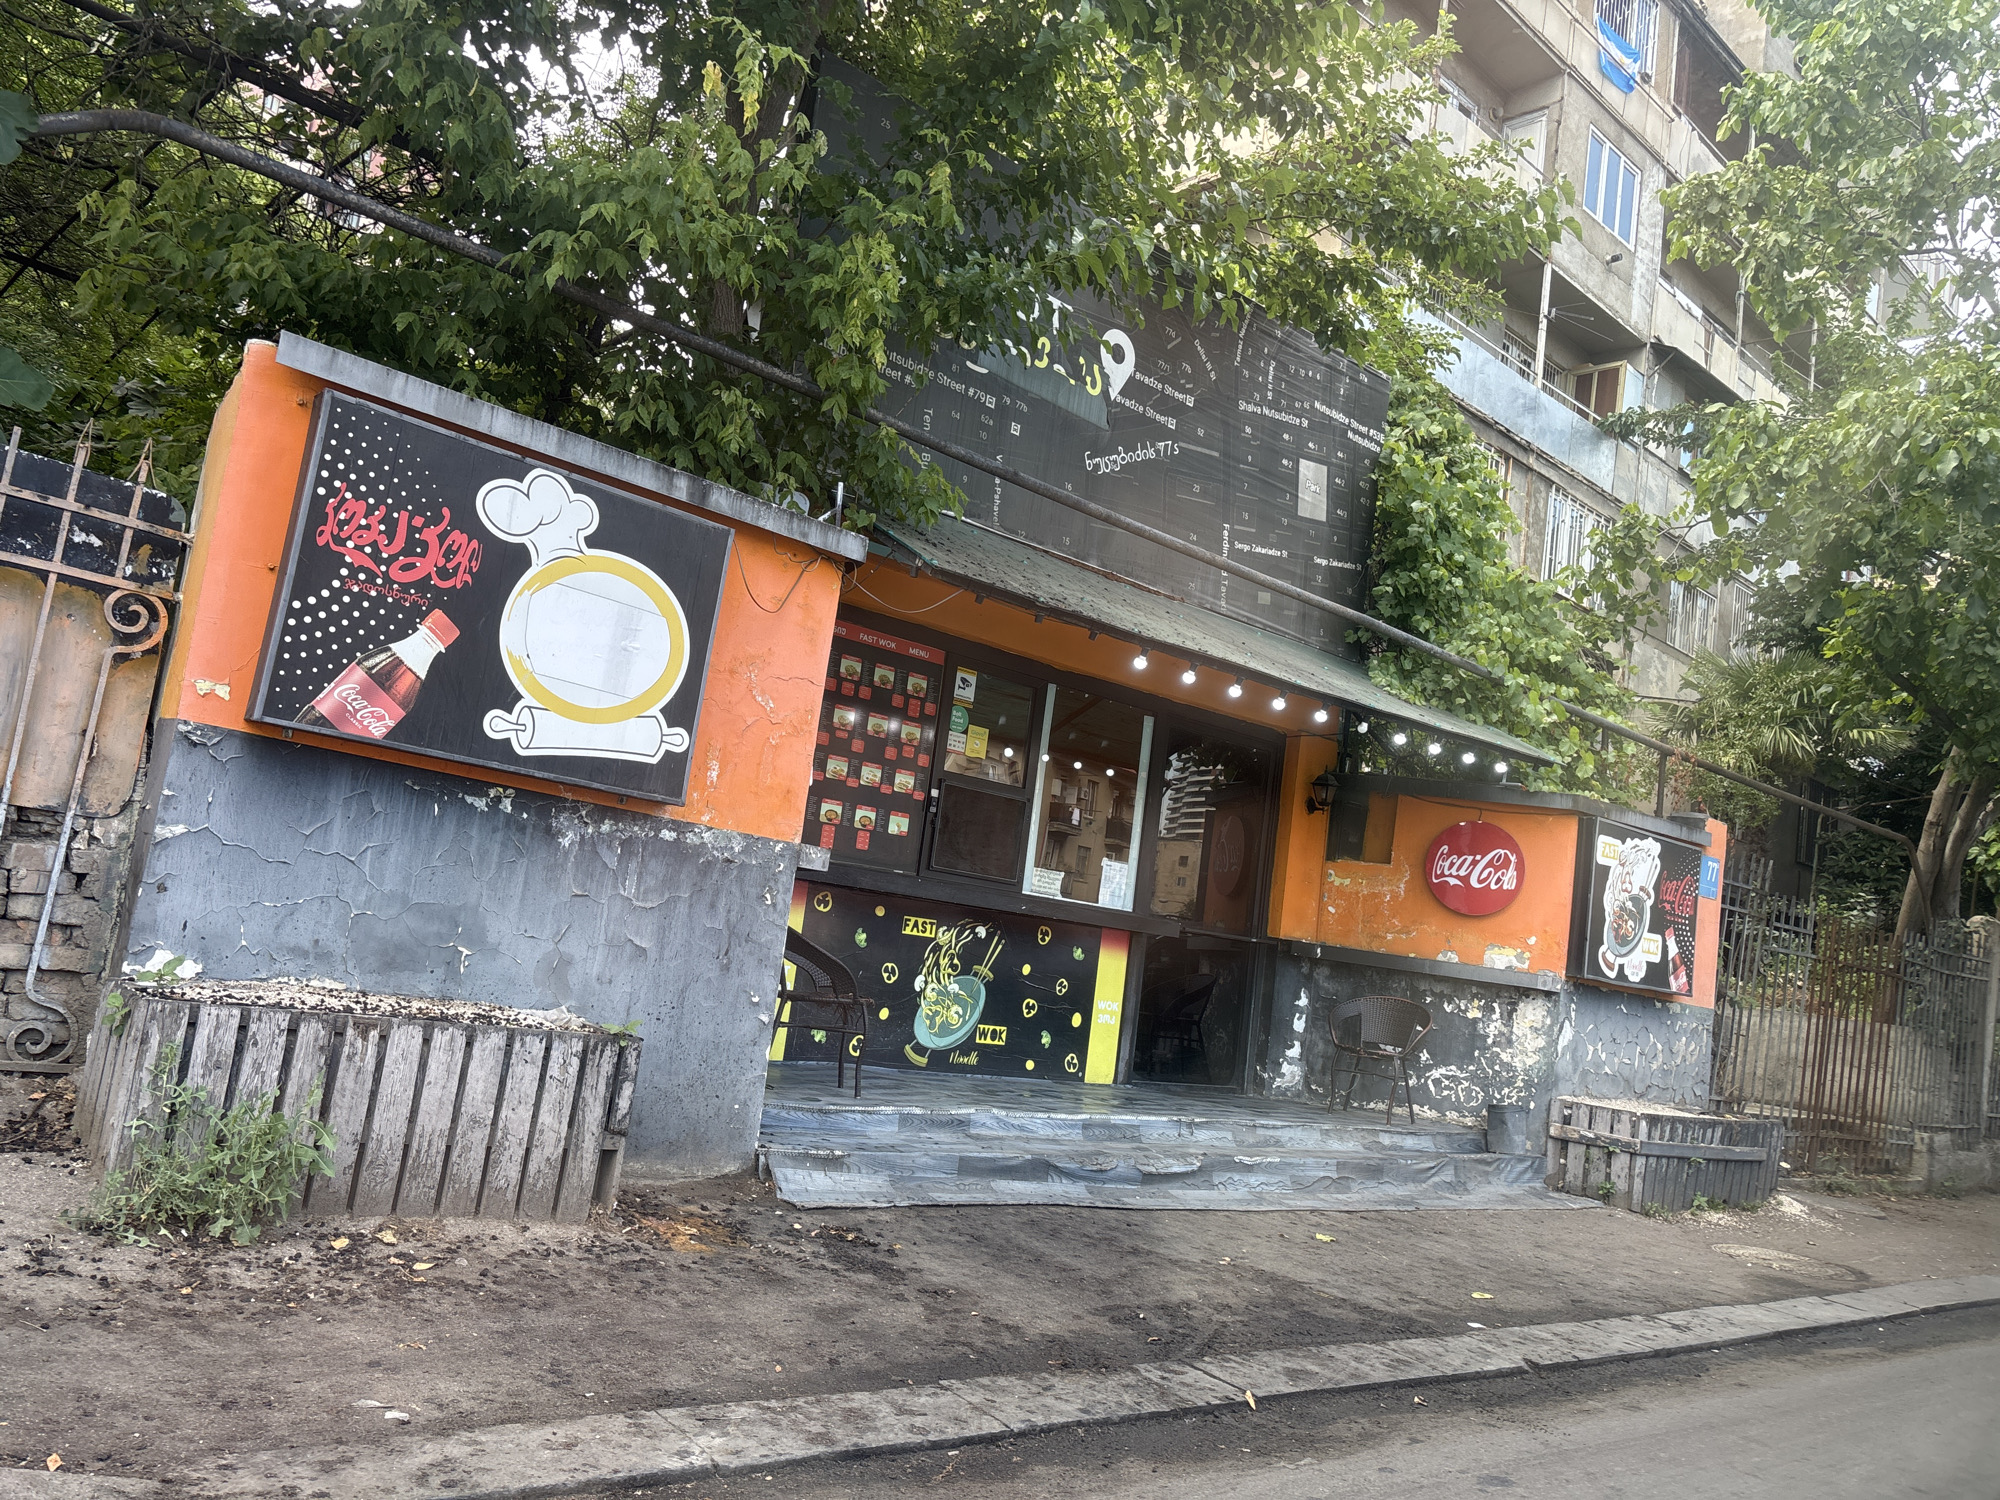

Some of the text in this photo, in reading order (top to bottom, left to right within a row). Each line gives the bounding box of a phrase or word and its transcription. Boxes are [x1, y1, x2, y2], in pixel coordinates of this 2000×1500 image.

[880, 117, 891, 129] 25
[951, 363, 960, 374] 81
[1288, 364, 1295, 374] 12
[936, 371, 966, 394] Street
[967, 386, 986, 403] #79
[1163, 383, 1187, 403] Street
[1002, 394, 1011, 406] 79
[951, 409, 961, 421] 64
[1115, 394, 1168, 426] avadze Street
[1238, 400, 1309, 429] Shalva Nutsubidze St
[1314, 400, 1350, 426] Nutsubidze
[1350, 418, 1369, 436] Street
[979, 430, 988, 441] 10
[1197, 427, 1205, 437] 52
[1347, 429, 1381, 454] Nutsubidze
[1064, 481, 1073, 491] 16
[1306, 480, 1321, 493] Park
[1018, 530, 1026, 539] 12
[1062, 536, 1071, 546] 15
[1189, 532, 1197, 542] 24
[1234, 540, 1288, 559] Sergo Zakariadze St
[1313, 555, 1329, 567] Sergo
[1356, 563, 1362, 571] St
[859, 632, 897, 650] FAST WOK
[908, 646, 930, 659] MENU
[333, 684, 396, 737] Coca-Cola
[952, 709, 963, 718] Bolt
[345, 712, 363, 730] CLASSIC
[952, 716, 964, 725] Food
[1601, 842, 1619, 860] FAST
[1432, 844, 1517, 890] Coca-Cola
[1707, 861, 1718, 882] 77
[903, 919, 936, 936] FAST
[1642, 938, 1660, 955] WOK
[1097, 1000, 1119, 1012] WOK
[977, 1026, 1006, 1043] WOK
[949, 1049, 980, 1066] Noodle
